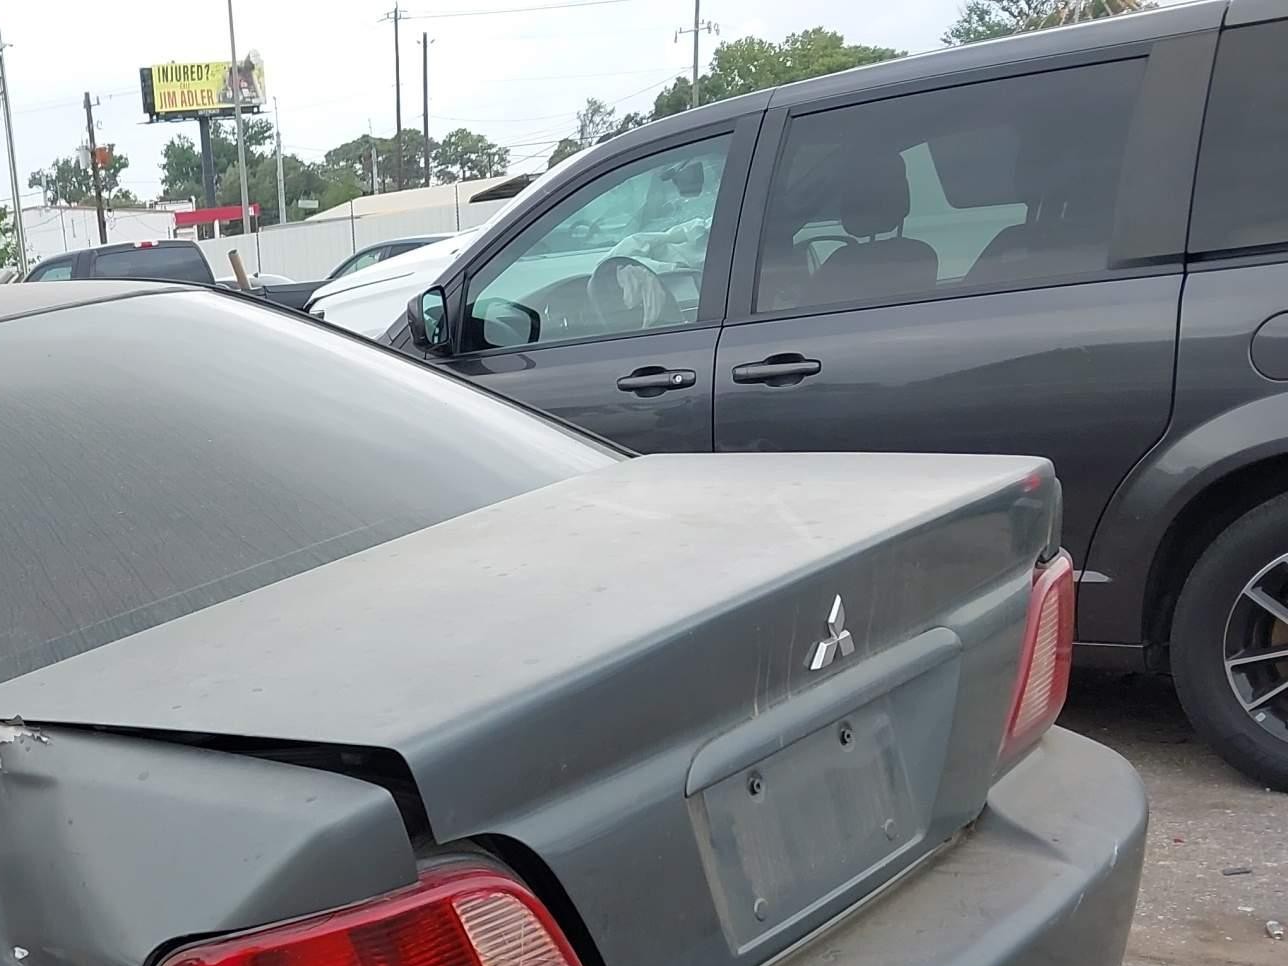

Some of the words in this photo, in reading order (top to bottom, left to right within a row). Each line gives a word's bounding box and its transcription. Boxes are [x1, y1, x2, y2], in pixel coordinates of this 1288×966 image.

[157, 64, 210, 83] INJURED?
[159, 91, 178, 110] JIM
[180, 89, 215, 108] ADLER
